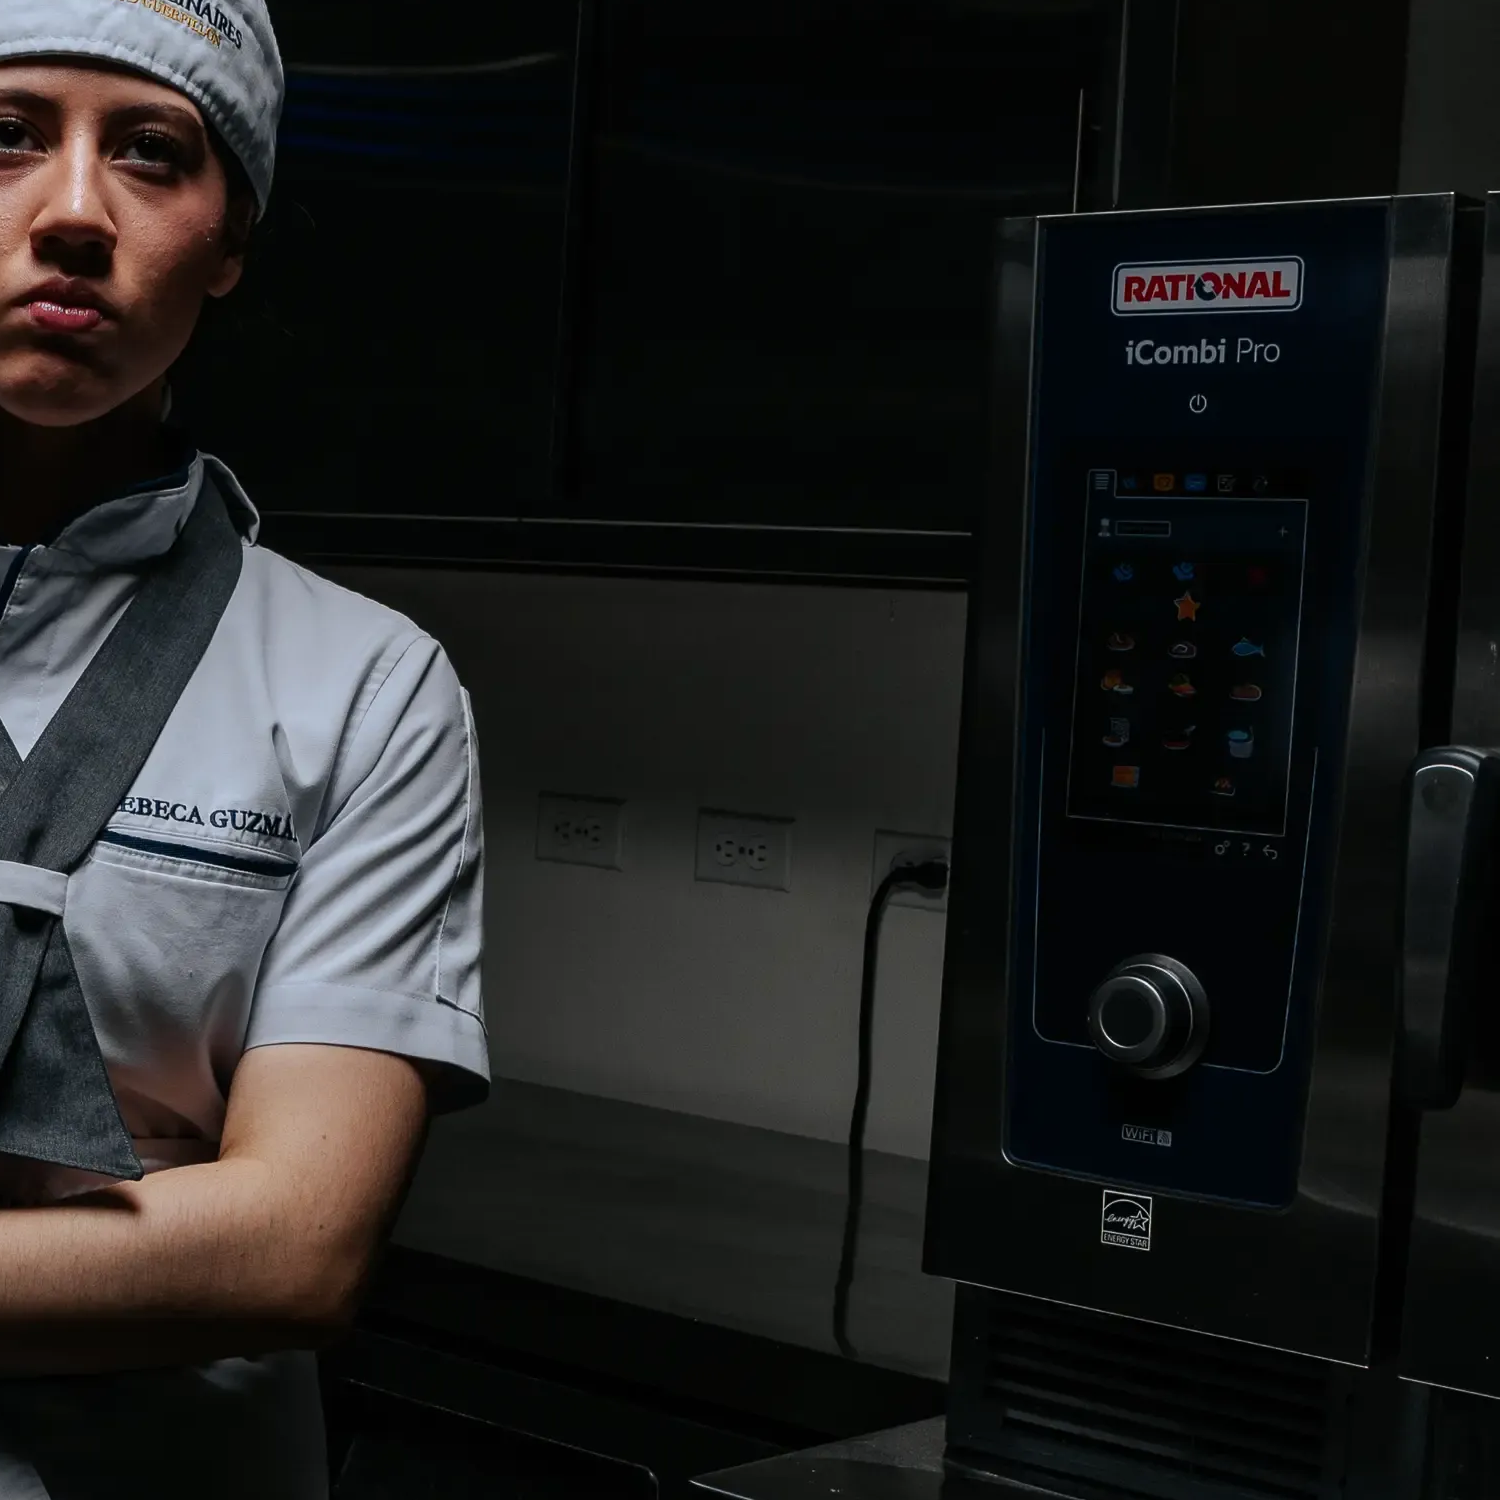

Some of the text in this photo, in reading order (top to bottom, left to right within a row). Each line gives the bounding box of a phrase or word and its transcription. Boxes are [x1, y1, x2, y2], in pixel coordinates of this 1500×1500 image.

[1124, 271, 1291, 302] RATIONAL
[1125, 338, 1280, 365] iCombi Pro
[116, 796, 205, 826] EBECA
[1124, 1127, 1153, 1141] WiFi
[1104, 1233, 1147, 1247] ENERGY STAR
